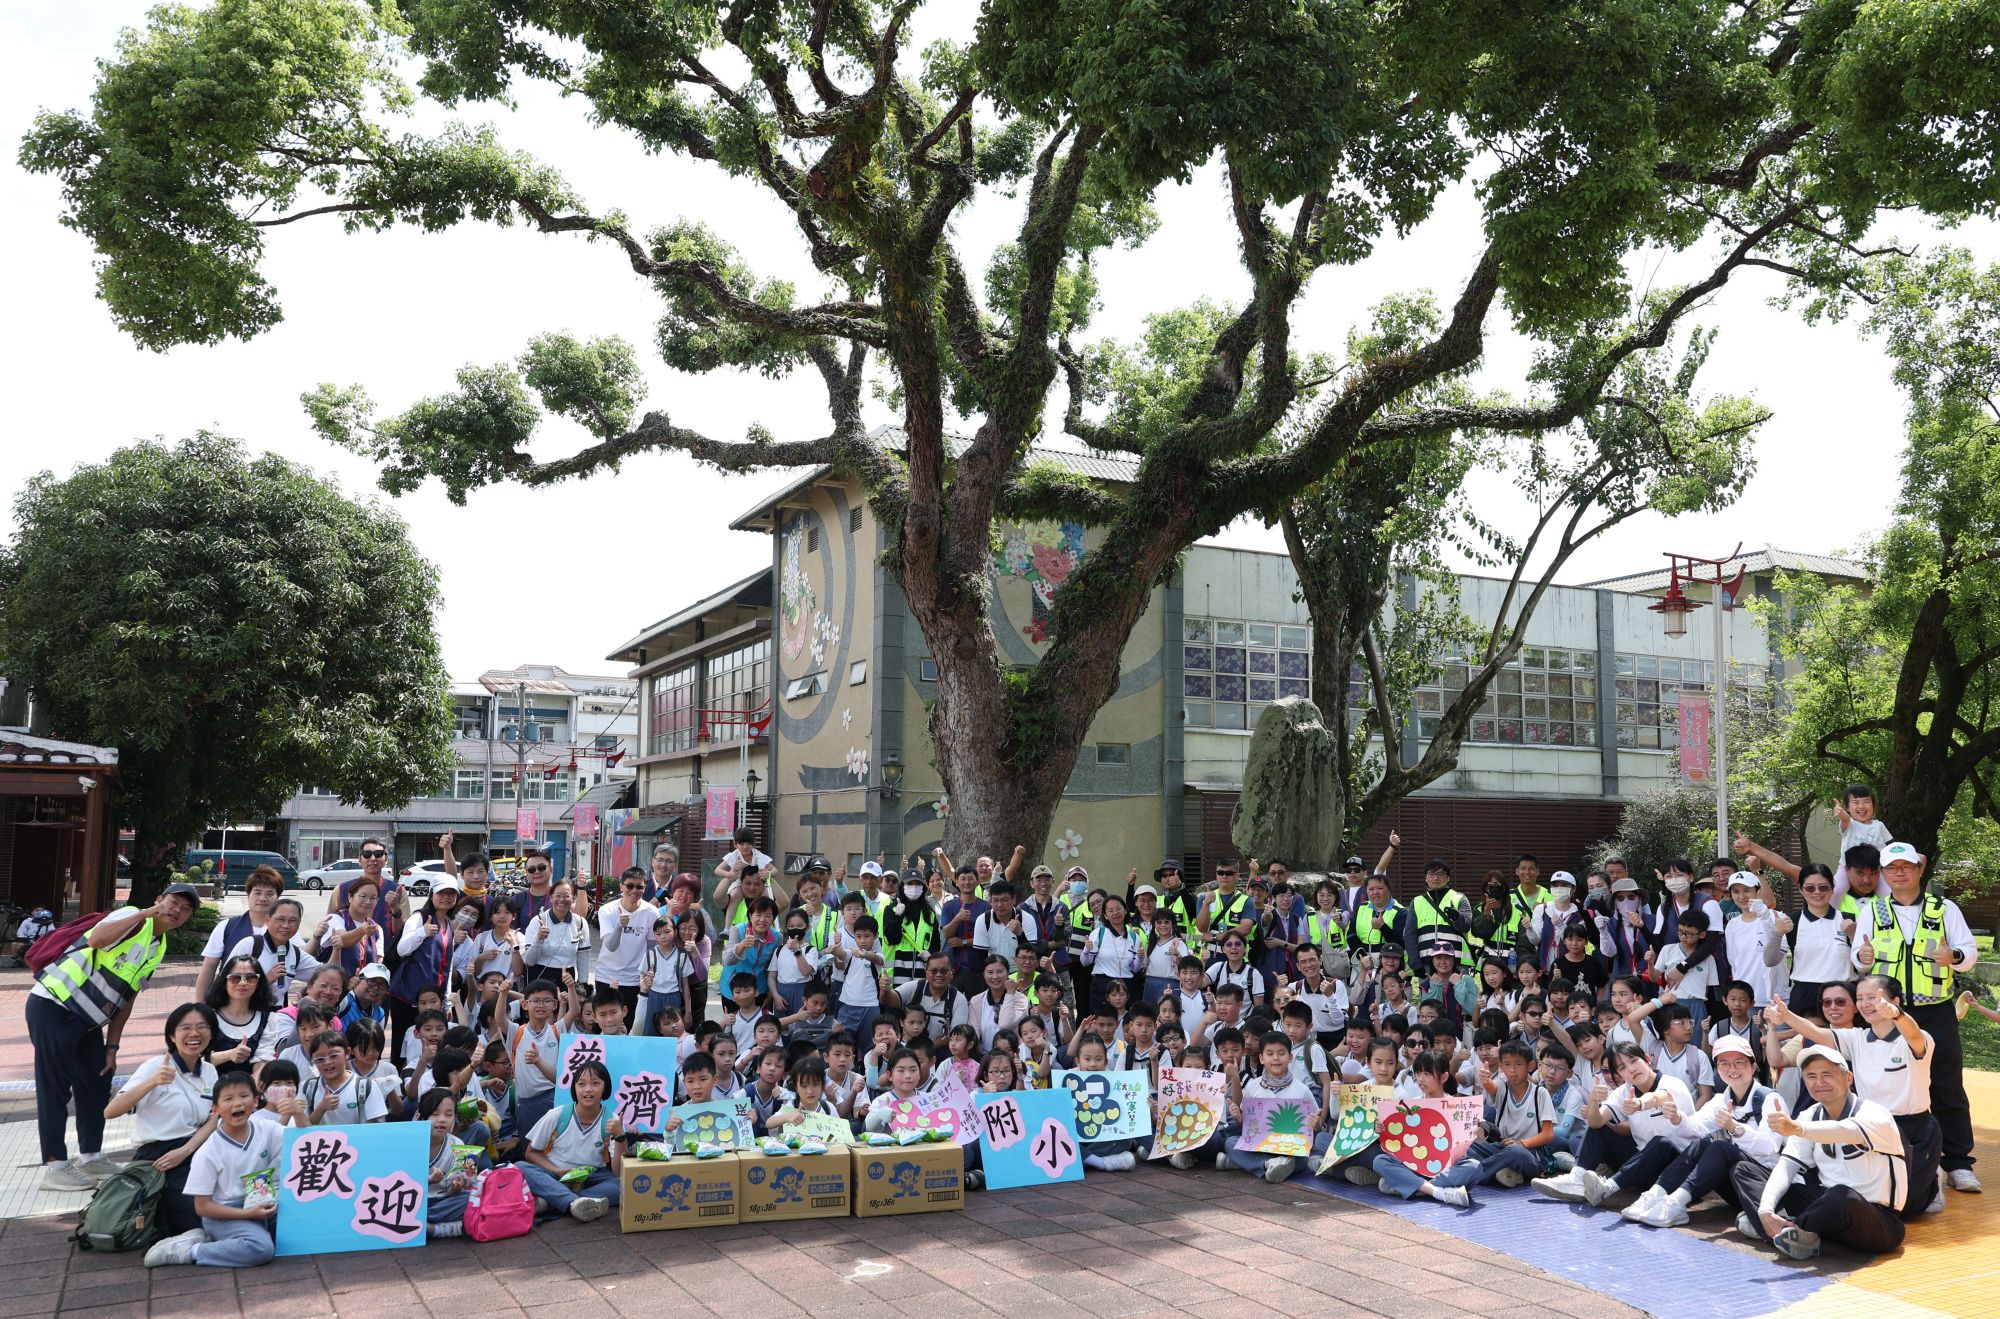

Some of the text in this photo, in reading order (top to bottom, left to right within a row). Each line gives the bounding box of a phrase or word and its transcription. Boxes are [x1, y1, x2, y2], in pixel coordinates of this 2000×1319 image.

[983, 1100, 1073, 1169] 附小
[1440, 1099, 1467, 1110] Thanks
[288, 1138, 420, 1234] 歡迎
